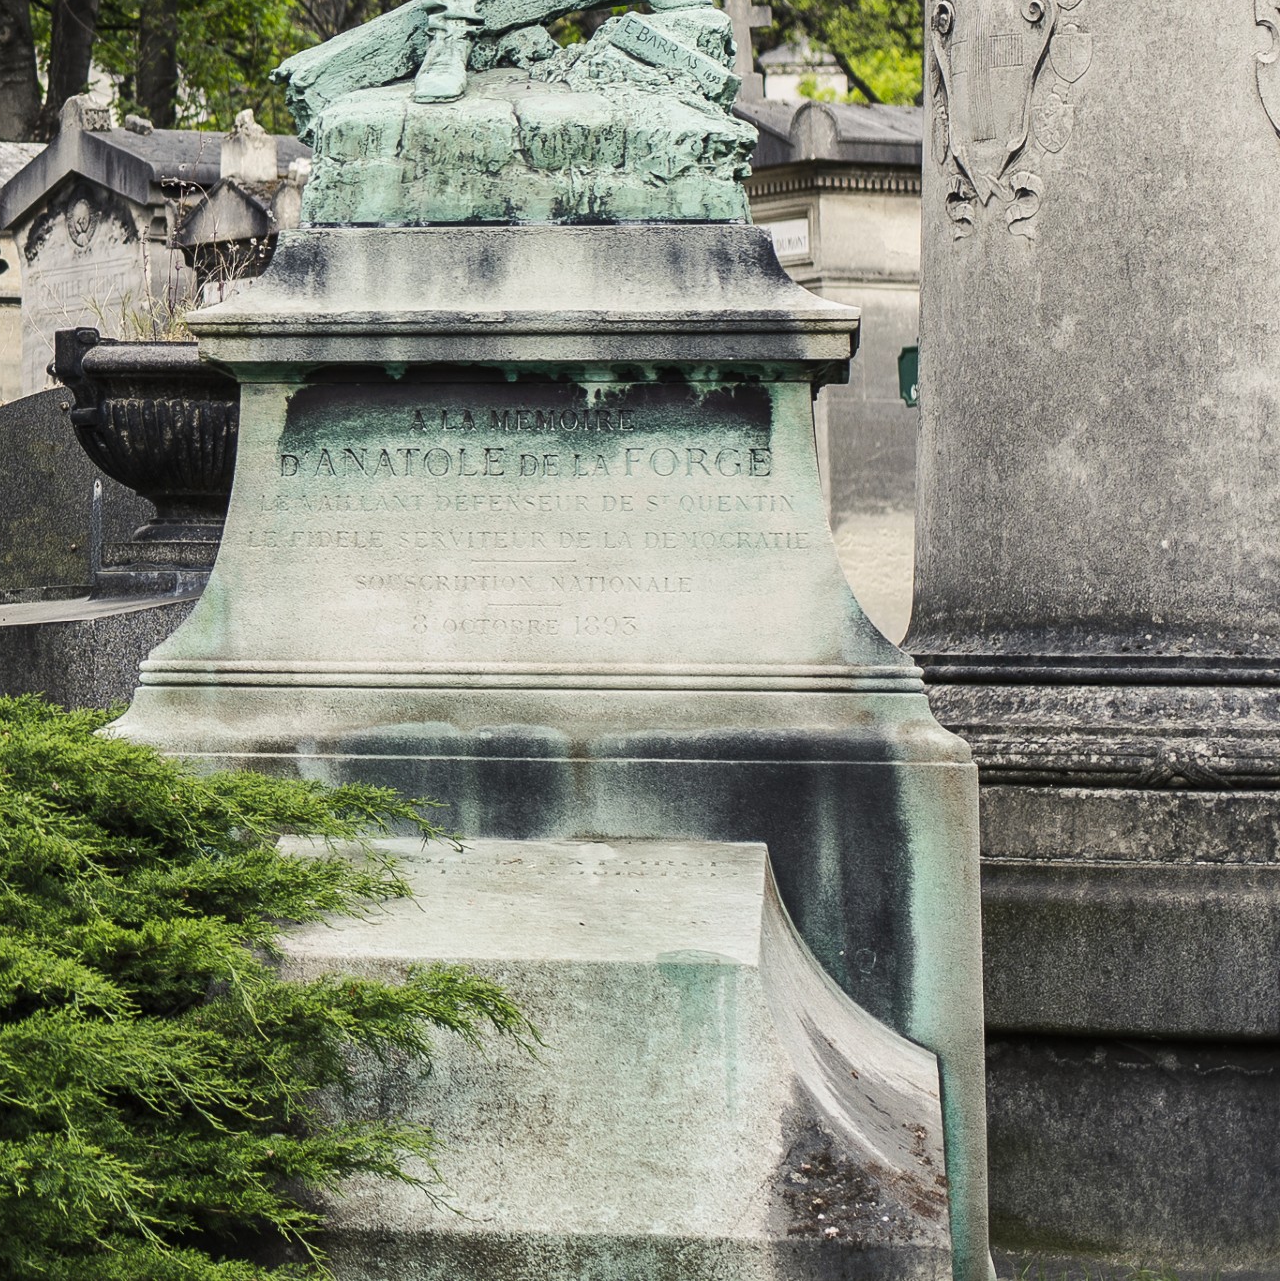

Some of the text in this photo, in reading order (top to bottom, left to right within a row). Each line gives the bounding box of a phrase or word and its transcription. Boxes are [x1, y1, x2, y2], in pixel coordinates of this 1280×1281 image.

[410, 410, 427, 431] A
[441, 410, 477, 431] LA
[519, 454, 559, 477] DE
[573, 454, 610, 477] LA
[624, 447, 773, 477] FORGE
[260, 495, 289, 512] LE
[301, 495, 424, 512] VAILLANT
[602, 495, 635, 512] DE
[679, 494, 794, 513] QUENTIN
[248, 531, 278, 549] LE
[398, 531, 547, 550] SERVITEUR
[559, 531, 592, 550] DE
[603, 531, 634, 550] LA
[354, 575, 692, 593] SOUSCRIPTION NATIONALE
[443, 618, 559, 636] OCTOBRE
